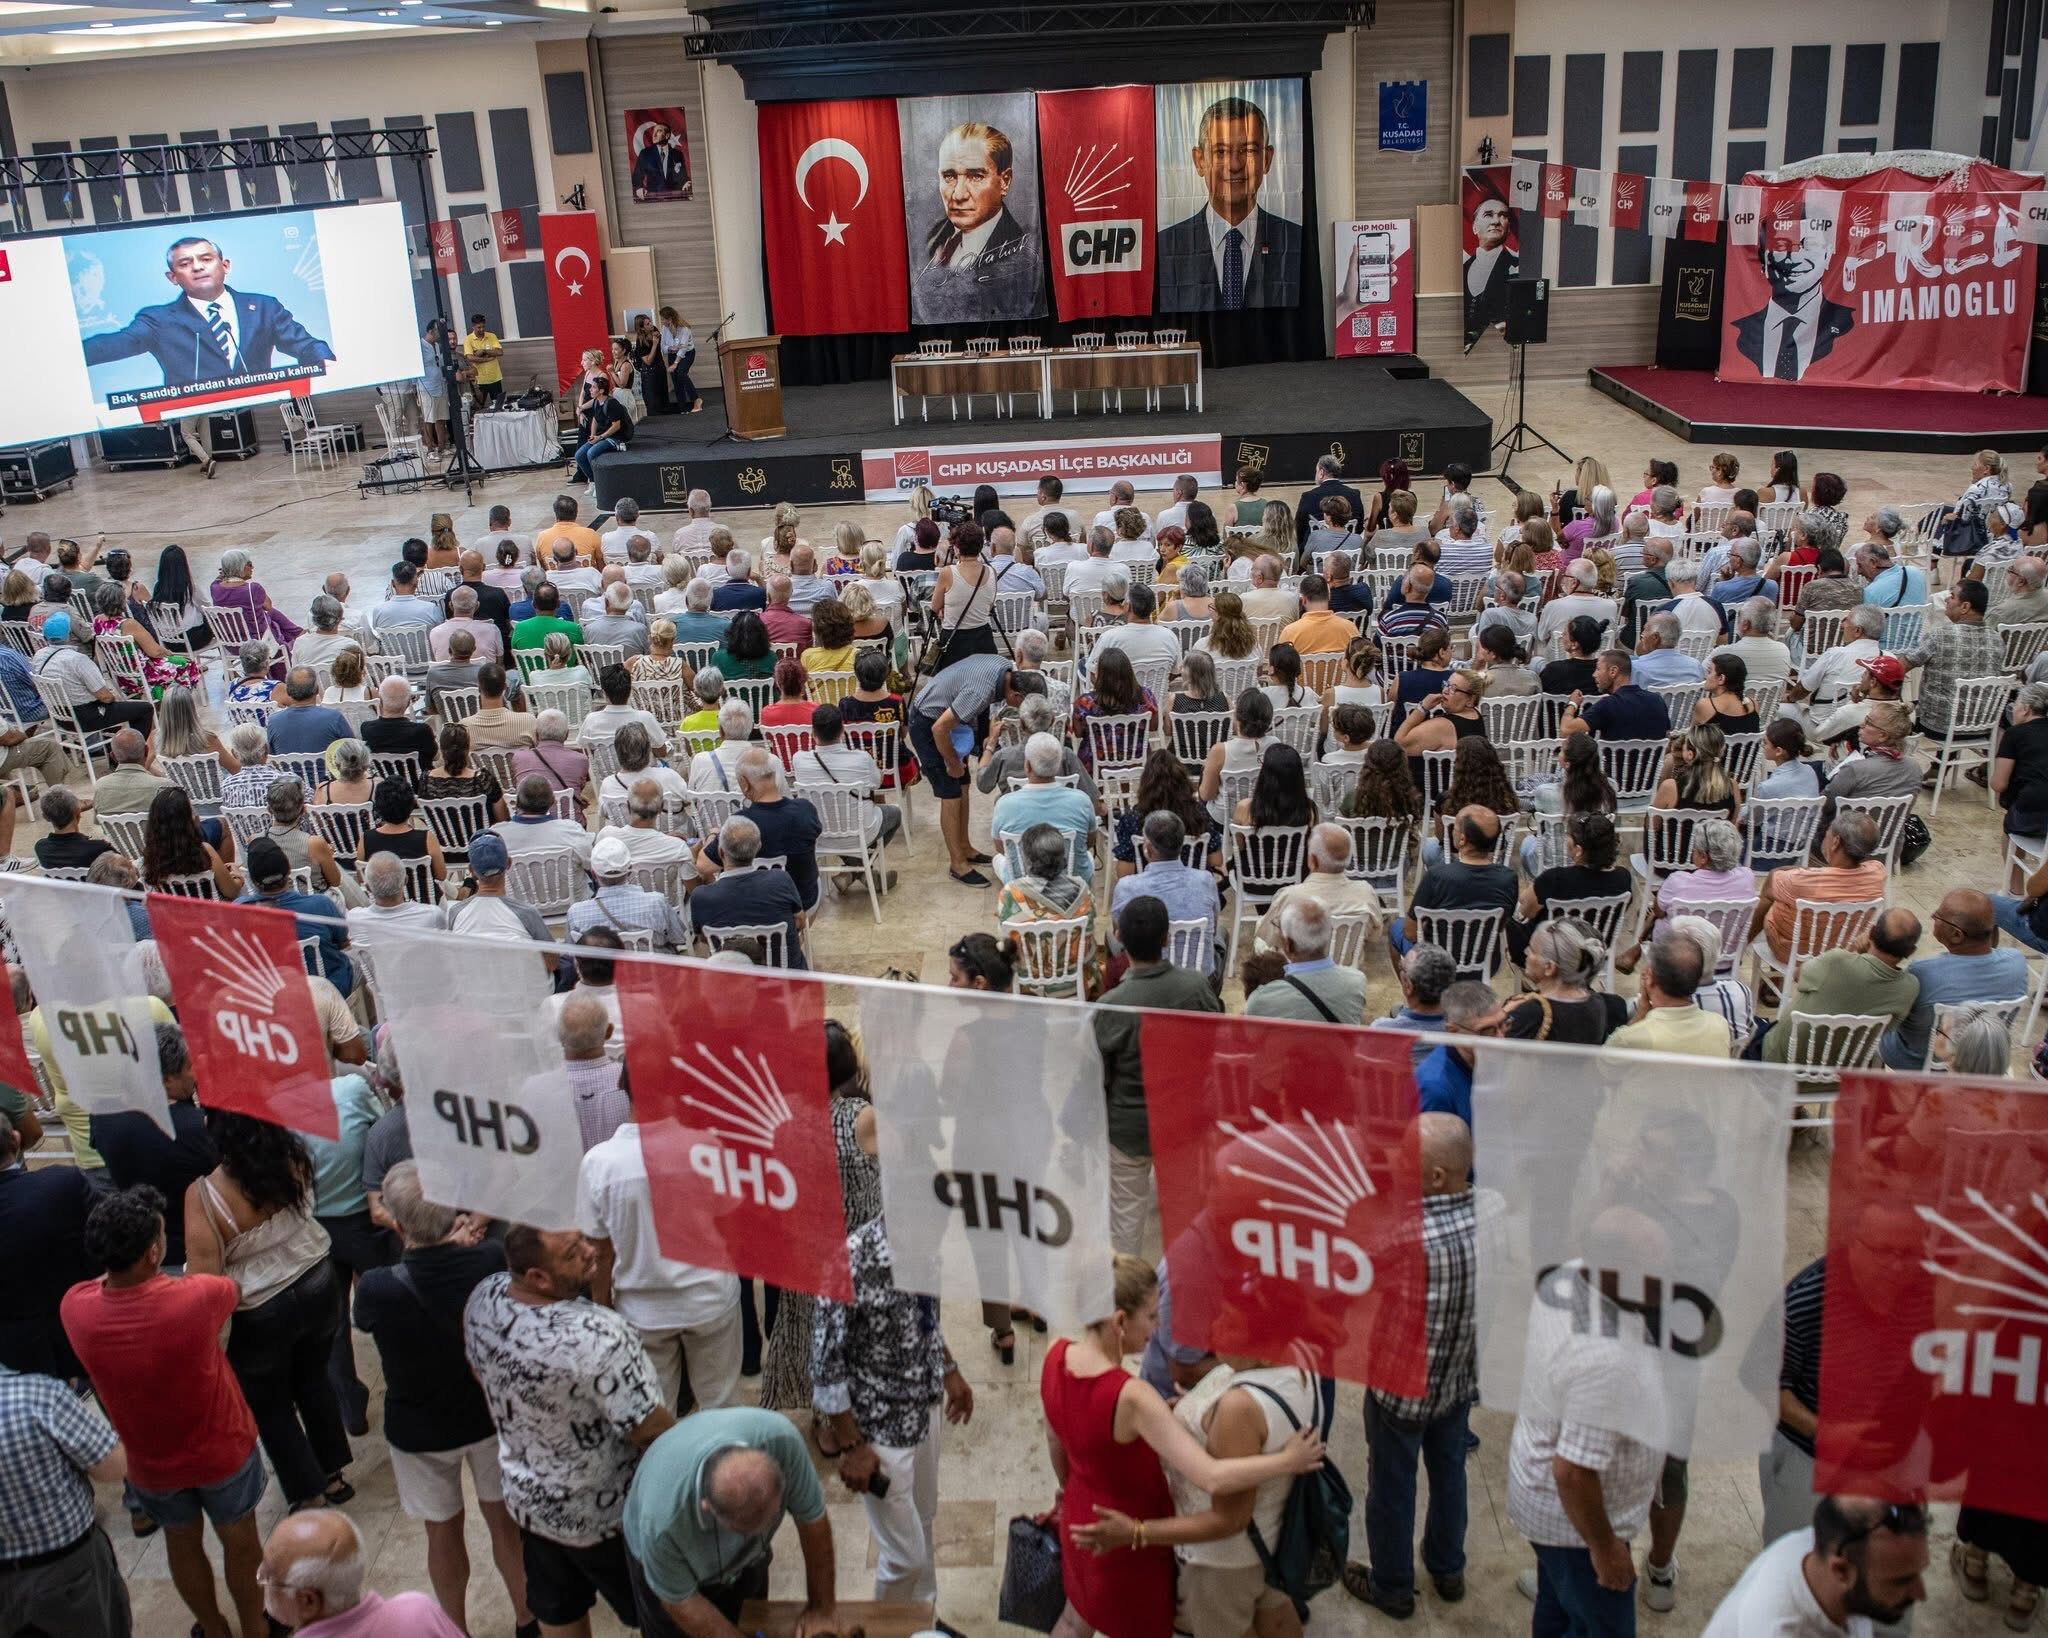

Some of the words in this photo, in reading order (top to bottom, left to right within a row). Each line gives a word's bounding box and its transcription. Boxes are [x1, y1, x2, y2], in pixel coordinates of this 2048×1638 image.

[1516, 180, 1533, 192] CHP
[1546, 190, 1565, 201] CHP
[1580, 196, 1597, 208] CHP
[1617, 199, 1634, 210] CHP
[1654, 204, 1673, 217] CHP
[1692, 212, 1711, 223] CHP
[1734, 212, 1755, 225] CHP
[1351, 224, 1369, 232] CHP
[1371, 222, 1398, 231] MOBİL
[1773, 220, 1793, 231] CHP
[1809, 218, 1833, 232] CHP
[1894, 219, 1917, 233] CHP
[1942, 225, 1966, 237] CHP
[1849, 226, 1871, 238] CHP
[472, 237, 490, 251] CHP
[502, 233, 518, 245] CHP
[438, 246, 455, 258] CHP
[1069, 228, 1136, 266] CHP
[1862, 279, 2016, 324] IMAMOGLU
[111, 391, 138, 406] Bak,
[140, 385, 182, 400] sandığı
[183, 378, 226, 394] ortadan
[227, 369, 286, 389] kaldırmaya
[938, 464, 973, 477] CHP
[976, 456, 1056, 477] KUŞADASI
[1059, 454, 1094, 473] İLÇE
[1096, 449, 1192, 471] BAŞKANLIĞI
[899, 477, 929, 489] CHP
